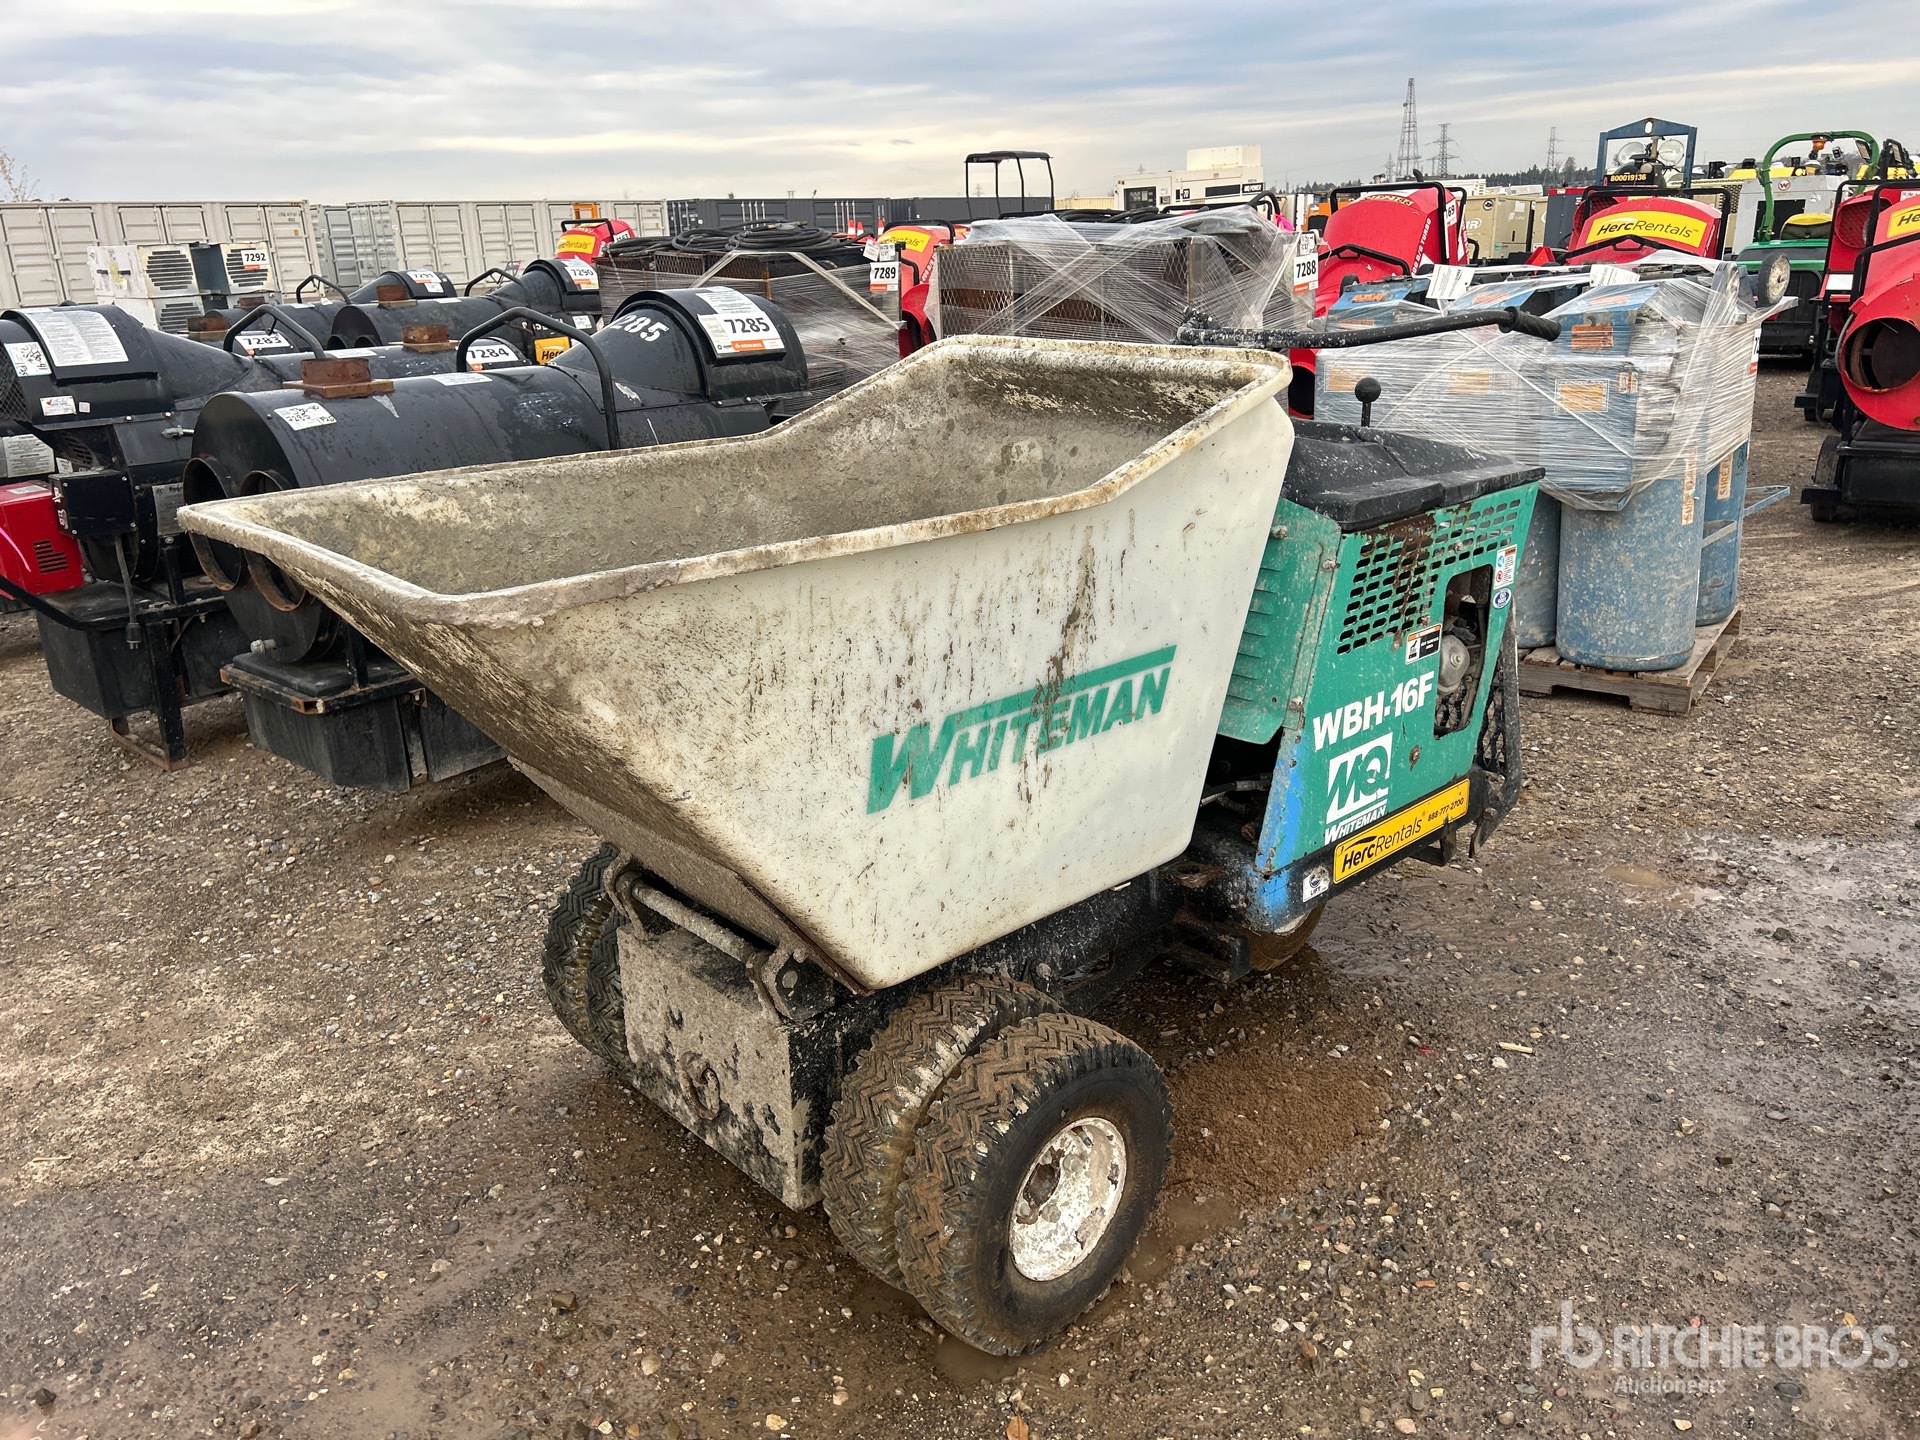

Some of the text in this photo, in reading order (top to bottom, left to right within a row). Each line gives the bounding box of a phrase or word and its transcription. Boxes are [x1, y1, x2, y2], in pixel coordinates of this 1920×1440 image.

[1421, 217, 1432, 245] TURBO
[1596, 219, 1693, 238] HercRentals
[244, 253, 266, 262] 7292
[570, 269, 594, 277] 7290
[874, 267, 896, 279] 7289
[1296, 260, 1317, 278] 7288
[724, 317, 771, 334] 7285
[242, 337, 282, 345] 7283
[467, 347, 509, 359] 7284
[1312, 670, 1435, 752] WBH-16F
[867, 645, 1177, 814] WHITEMAN
[1326, 740, 1393, 824] MQ
[1325, 800, 1388, 845] WHITEMAN
[1341, 816, 1424, 874] HercRentals
